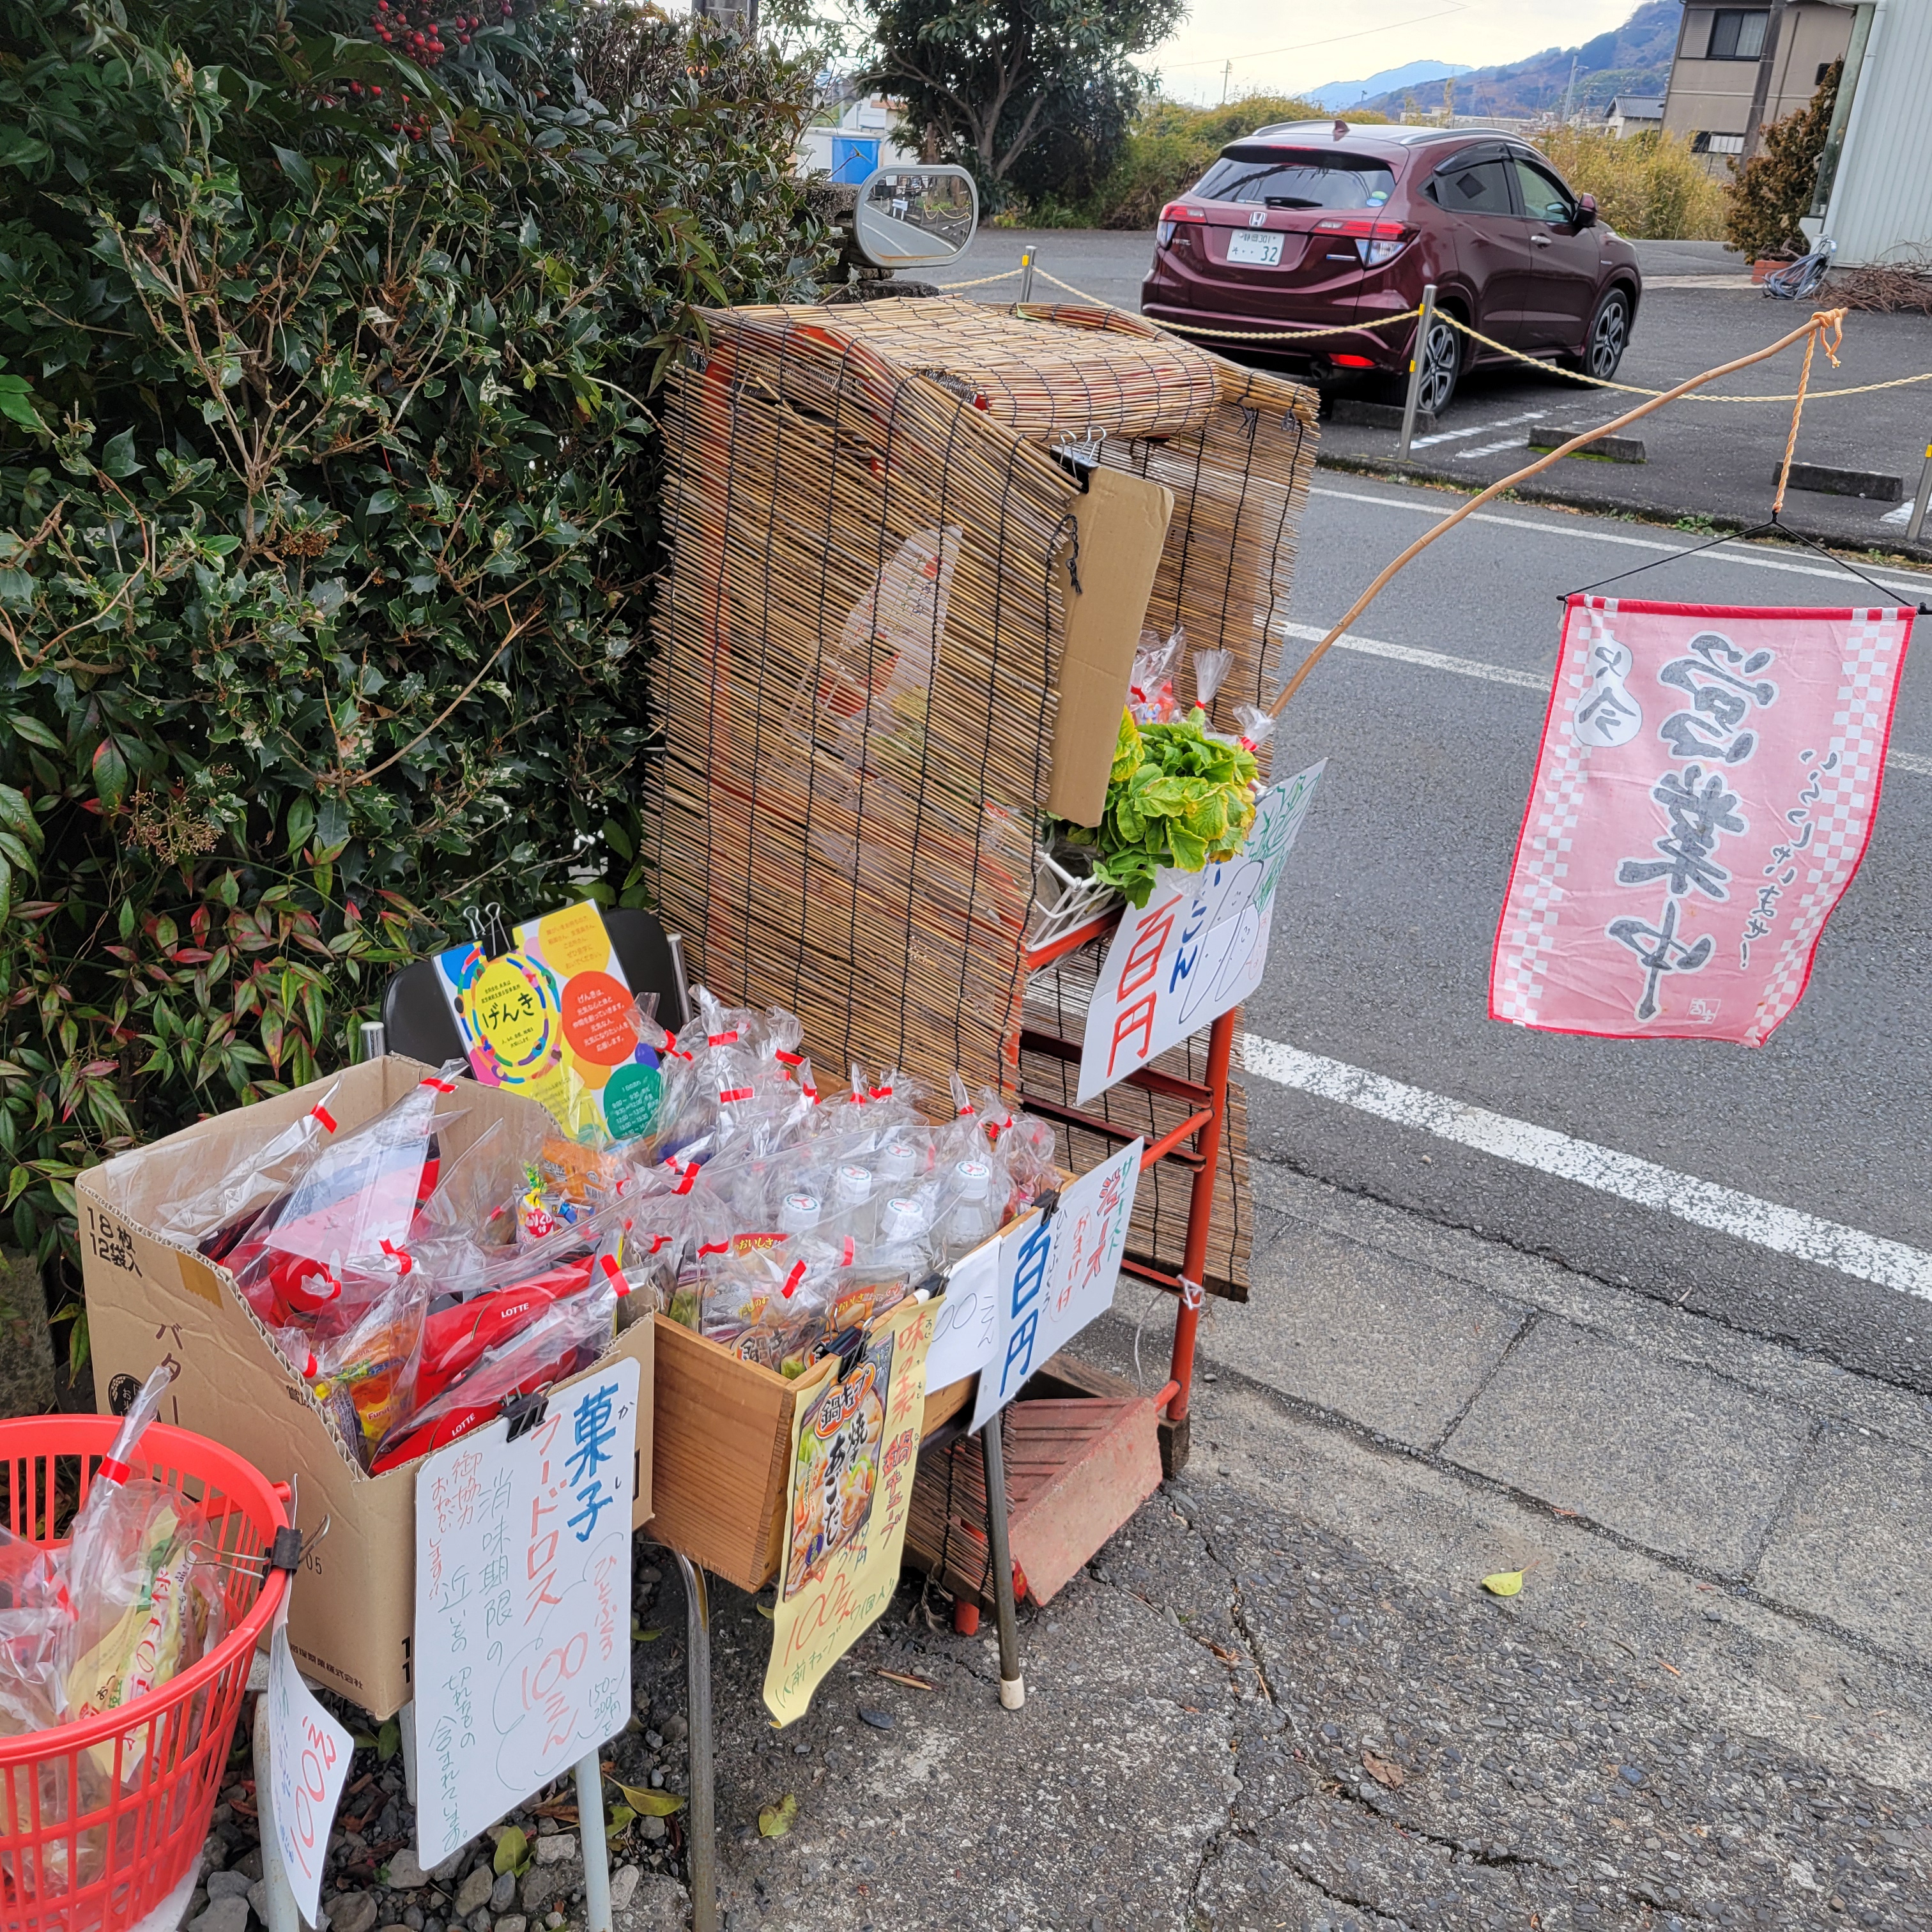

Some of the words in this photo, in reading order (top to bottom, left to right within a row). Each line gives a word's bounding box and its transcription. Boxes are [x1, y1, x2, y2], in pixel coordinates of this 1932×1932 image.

[1607, 634, 1774, 1020] 営業中
[482, 992, 535, 1030] げんき
[1106, 893, 1183, 1079] 百円
[87, 1205, 136, 1255] 18枚
[89, 1231, 142, 1278] 12袋入
[1082, 1167, 1122, 1289] ジュース
[500, 1301, 530, 1319] LOTTE
[999, 1218, 1052, 1399] 百円
[155, 1322, 183, 1425] バター
[451, 1412, 476, 1437] LOTTE
[890, 1310, 928, 1427] 味の素
[523, 1412, 567, 1627] フードロス
[564, 1382, 619, 1543] 菓子
[880, 1427, 914, 1551] 鍋キューブ
